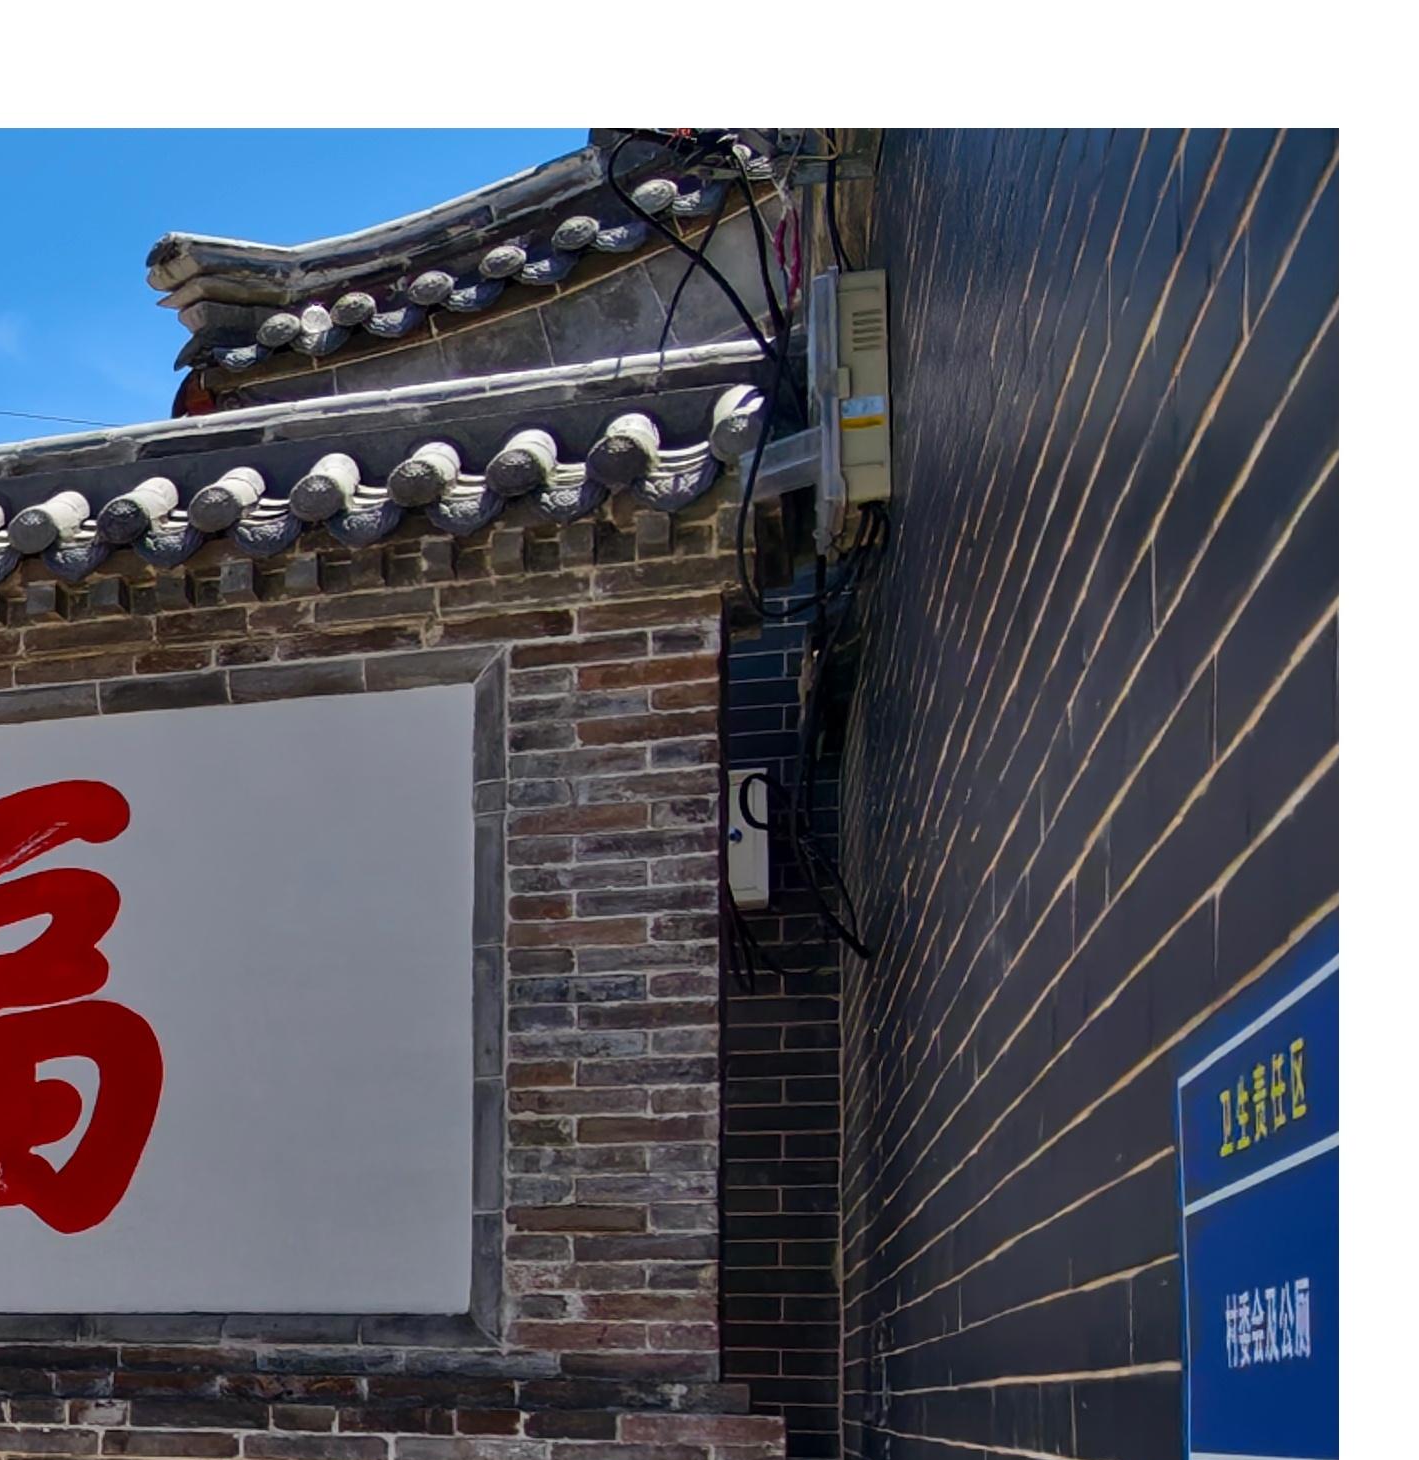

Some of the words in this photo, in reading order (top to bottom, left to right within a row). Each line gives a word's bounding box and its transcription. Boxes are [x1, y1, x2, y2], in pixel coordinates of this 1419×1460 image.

[1219, 1037, 1307, 1157] 卫生责任区
[1225, 1277, 1311, 1369] 村委会及公厕
